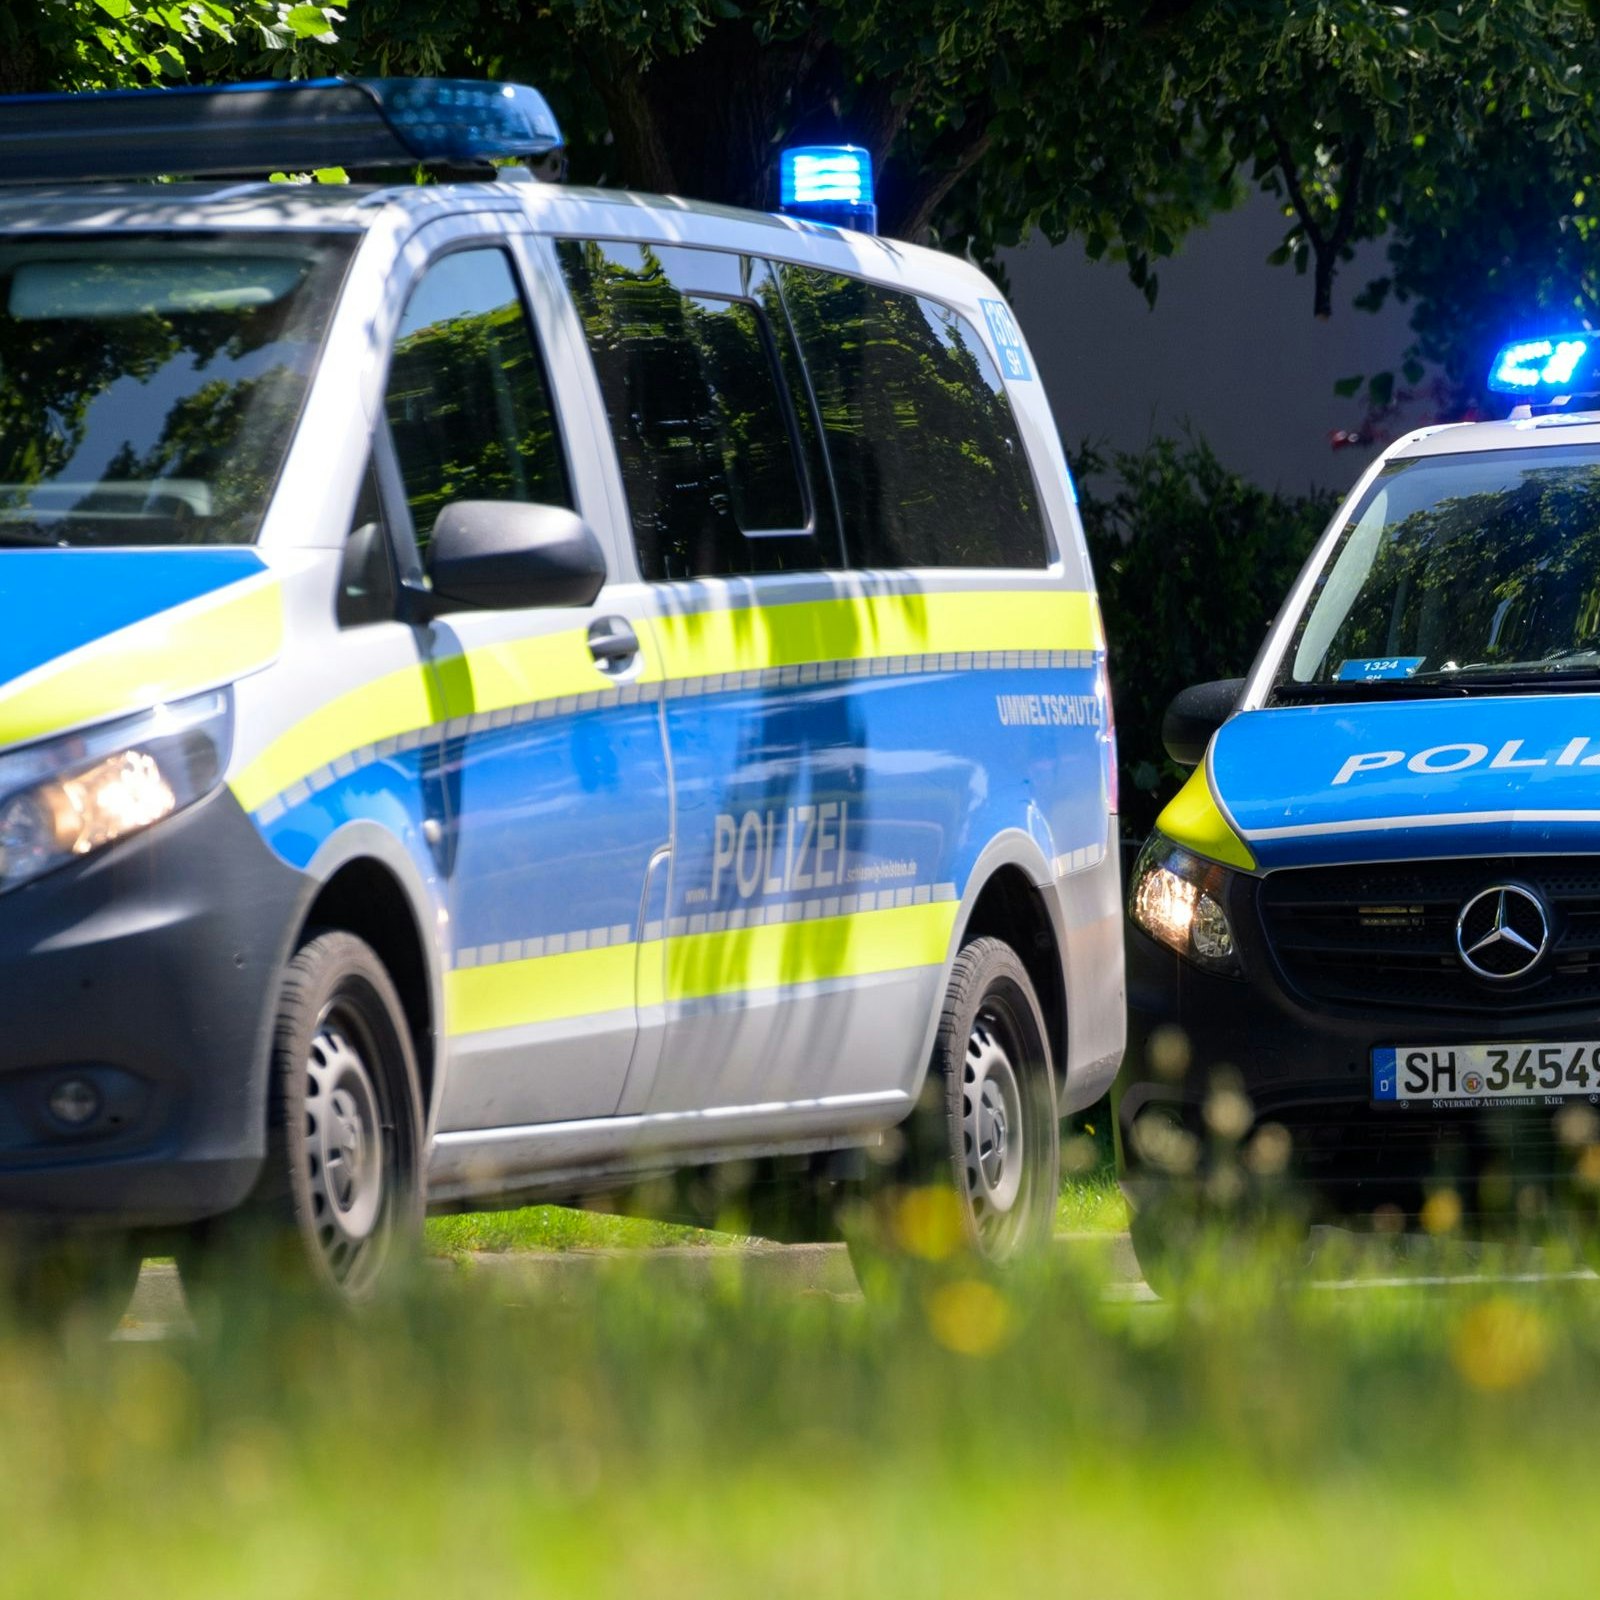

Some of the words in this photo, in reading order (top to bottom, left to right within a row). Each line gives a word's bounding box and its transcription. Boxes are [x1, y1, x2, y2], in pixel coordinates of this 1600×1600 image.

[1363, 660, 1399, 671] 1324
[995, 694, 1101, 726] UMWELTSCHUTZ
[711, 800, 847, 901] POLIZEI
[1380, 1080, 1389, 1092] D
[1404, 1051, 1457, 1093] SH
